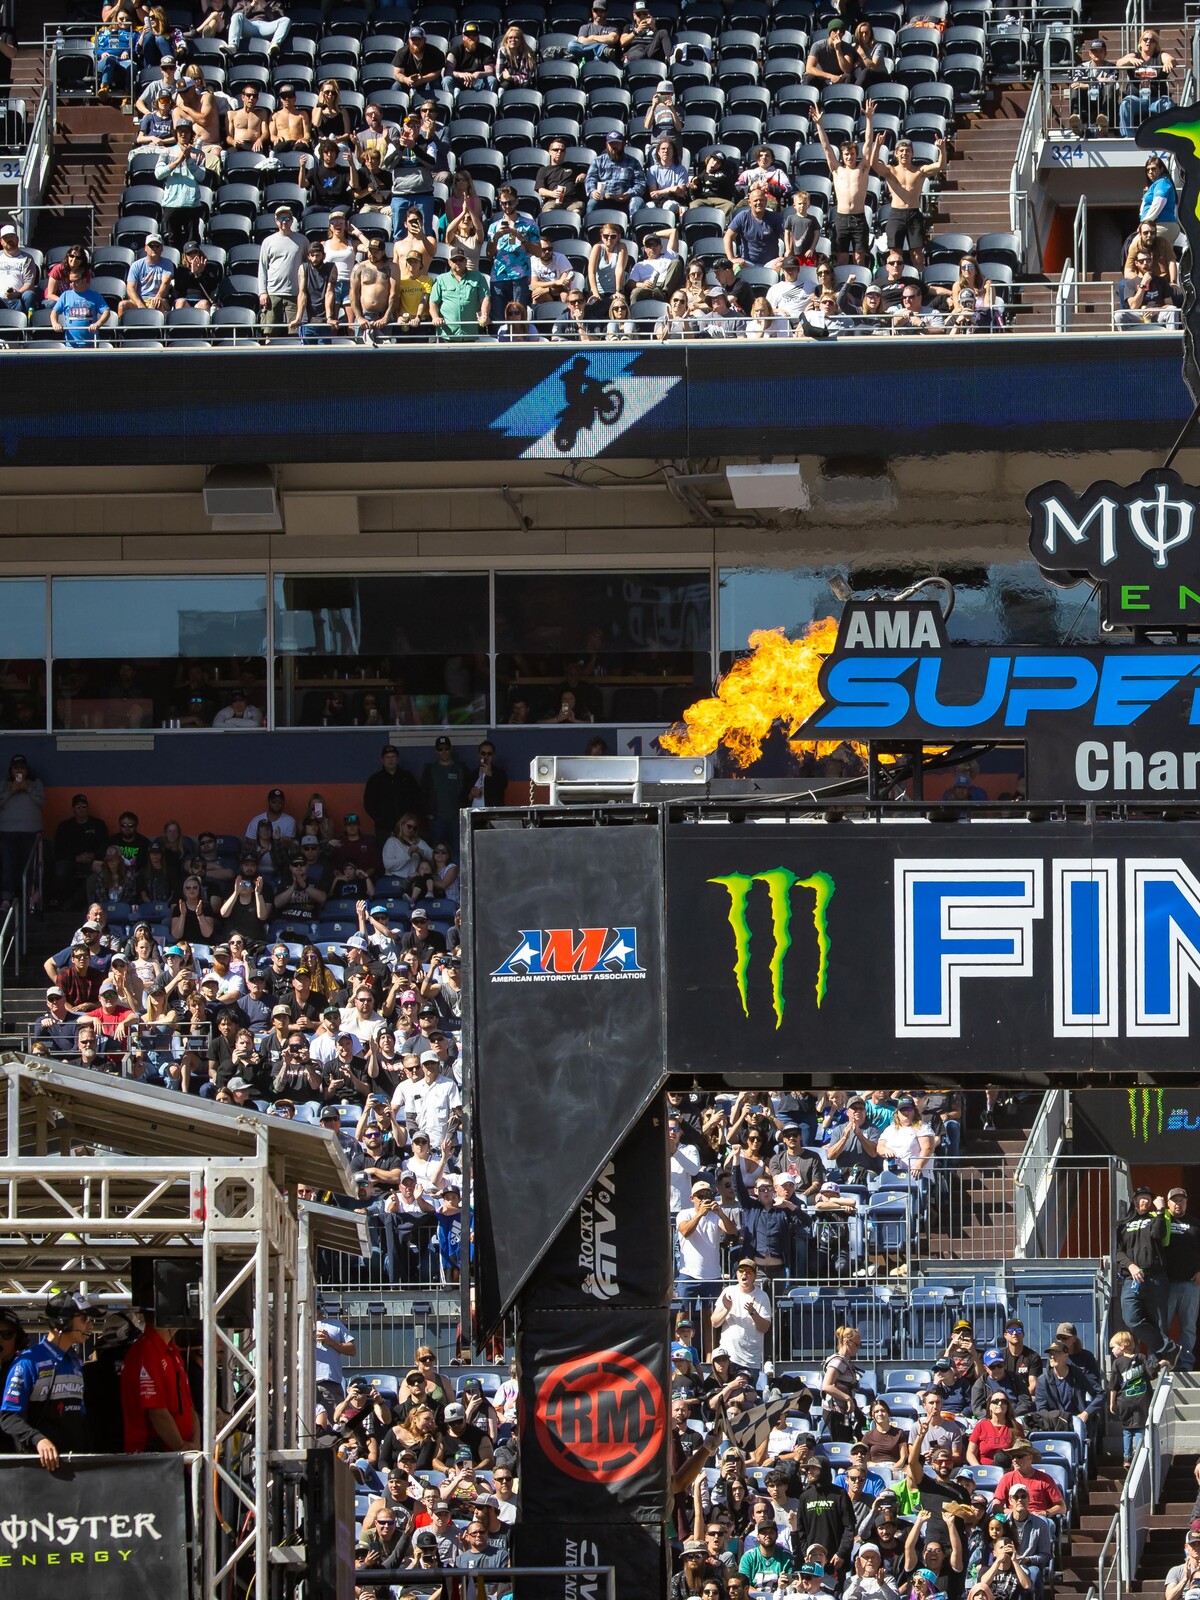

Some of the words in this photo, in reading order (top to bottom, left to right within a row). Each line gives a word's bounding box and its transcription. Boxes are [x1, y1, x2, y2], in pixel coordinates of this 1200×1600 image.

[1051, 145, 1084, 162] 324
[845, 611, 942, 649] AMA
[489, 927, 647, 975] AMA
[534, 974, 593, 982] MOTORCYCLIST
[594, 972, 646, 981] ASSOCIATION
[560, 1391, 648, 1445] RM
[0, 1512, 162, 1550] ONSTER
[0, 1549, 133, 1567] ENERGY
